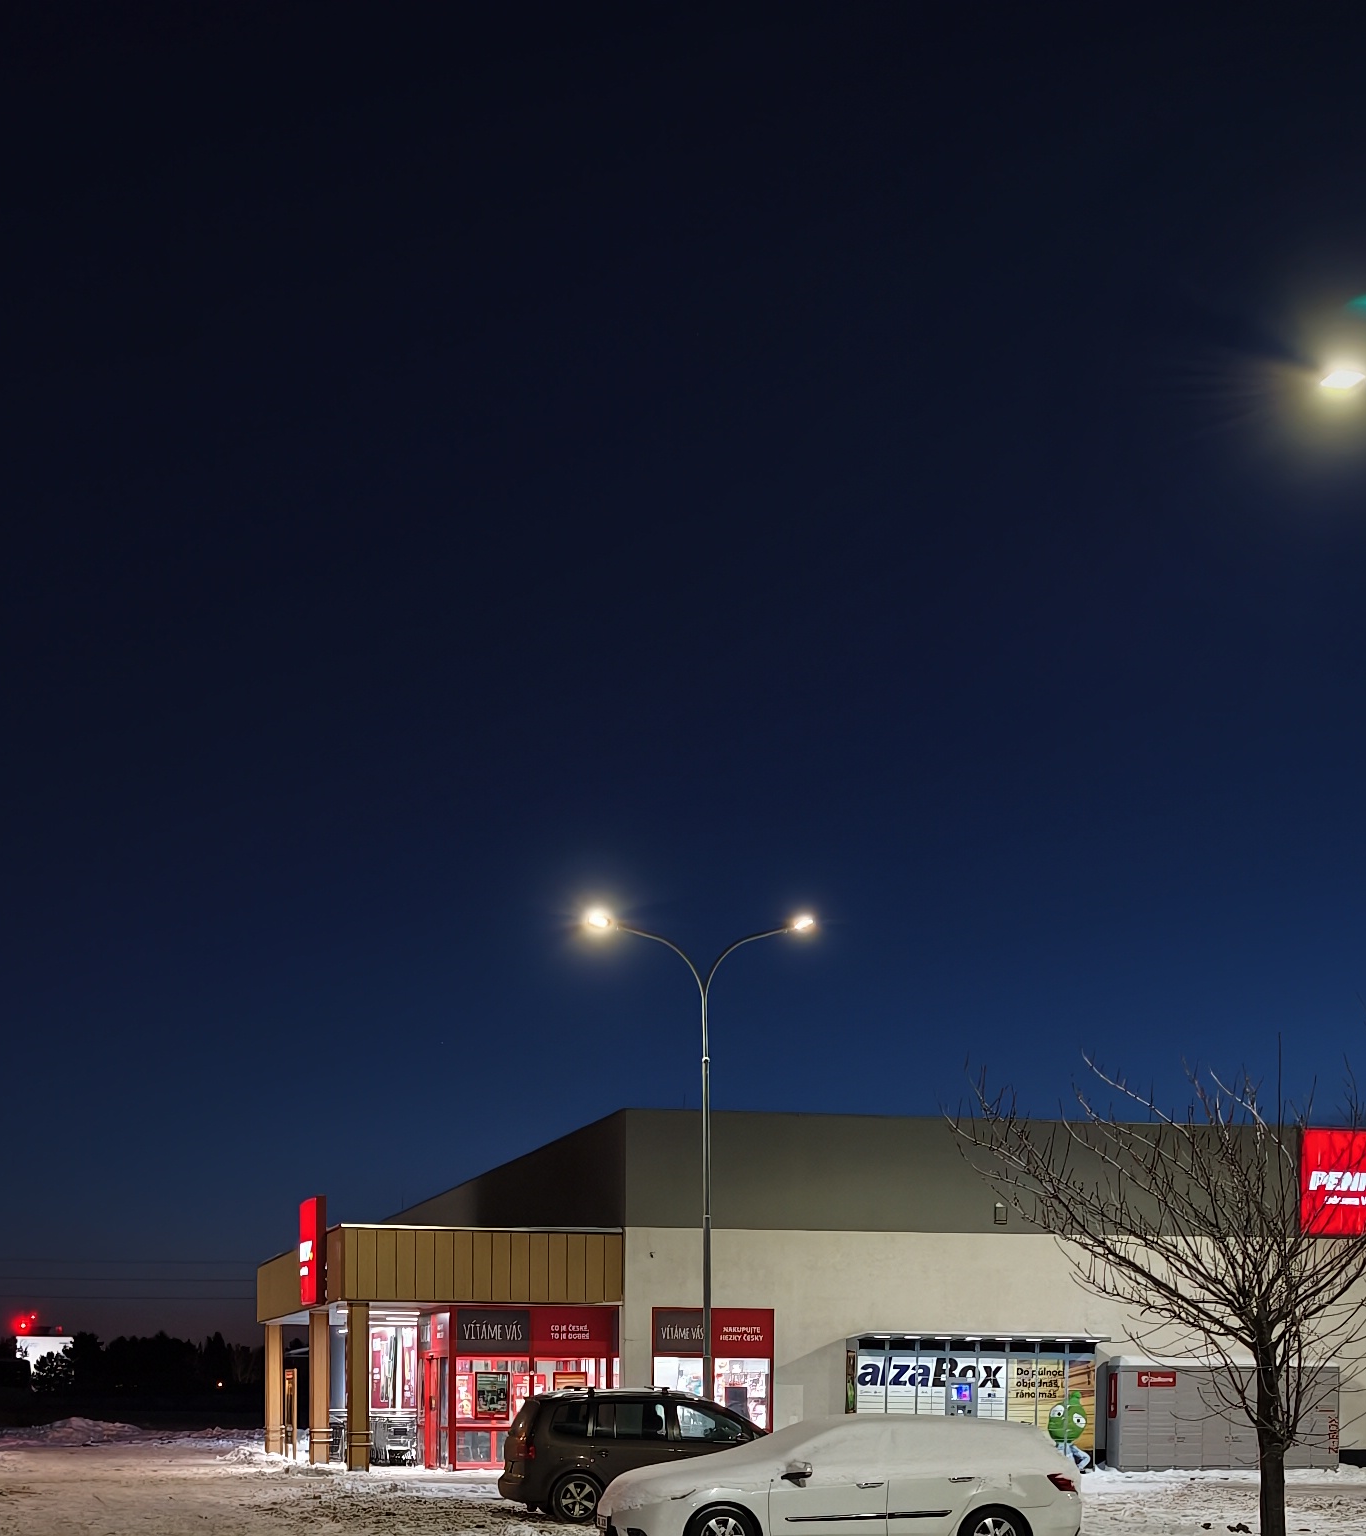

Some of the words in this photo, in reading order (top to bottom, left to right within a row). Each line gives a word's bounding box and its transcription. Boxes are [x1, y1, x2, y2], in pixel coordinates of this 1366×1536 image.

[462, 1319, 503, 1340] VÍTÁME
[504, 1320, 523, 1341] VÁS
[550, 1324, 560, 1332] CO
[661, 1324, 690, 1340] VÍTÁME
[691, 1324, 705, 1340] VÁS
[722, 1326, 761, 1334] NAKUPUJTE
[550, 1332, 560, 1340] TO
[719, 1334, 742, 1342] HEZKY
[742, 1333, 764, 1342] ČESKY
[857, 1356, 1003, 1388] alzaBox
[1016, 1367, 1030, 1376] Do
[1015, 1390, 1036, 1399] ráno
[1038, 1389, 1057, 1399] máš
